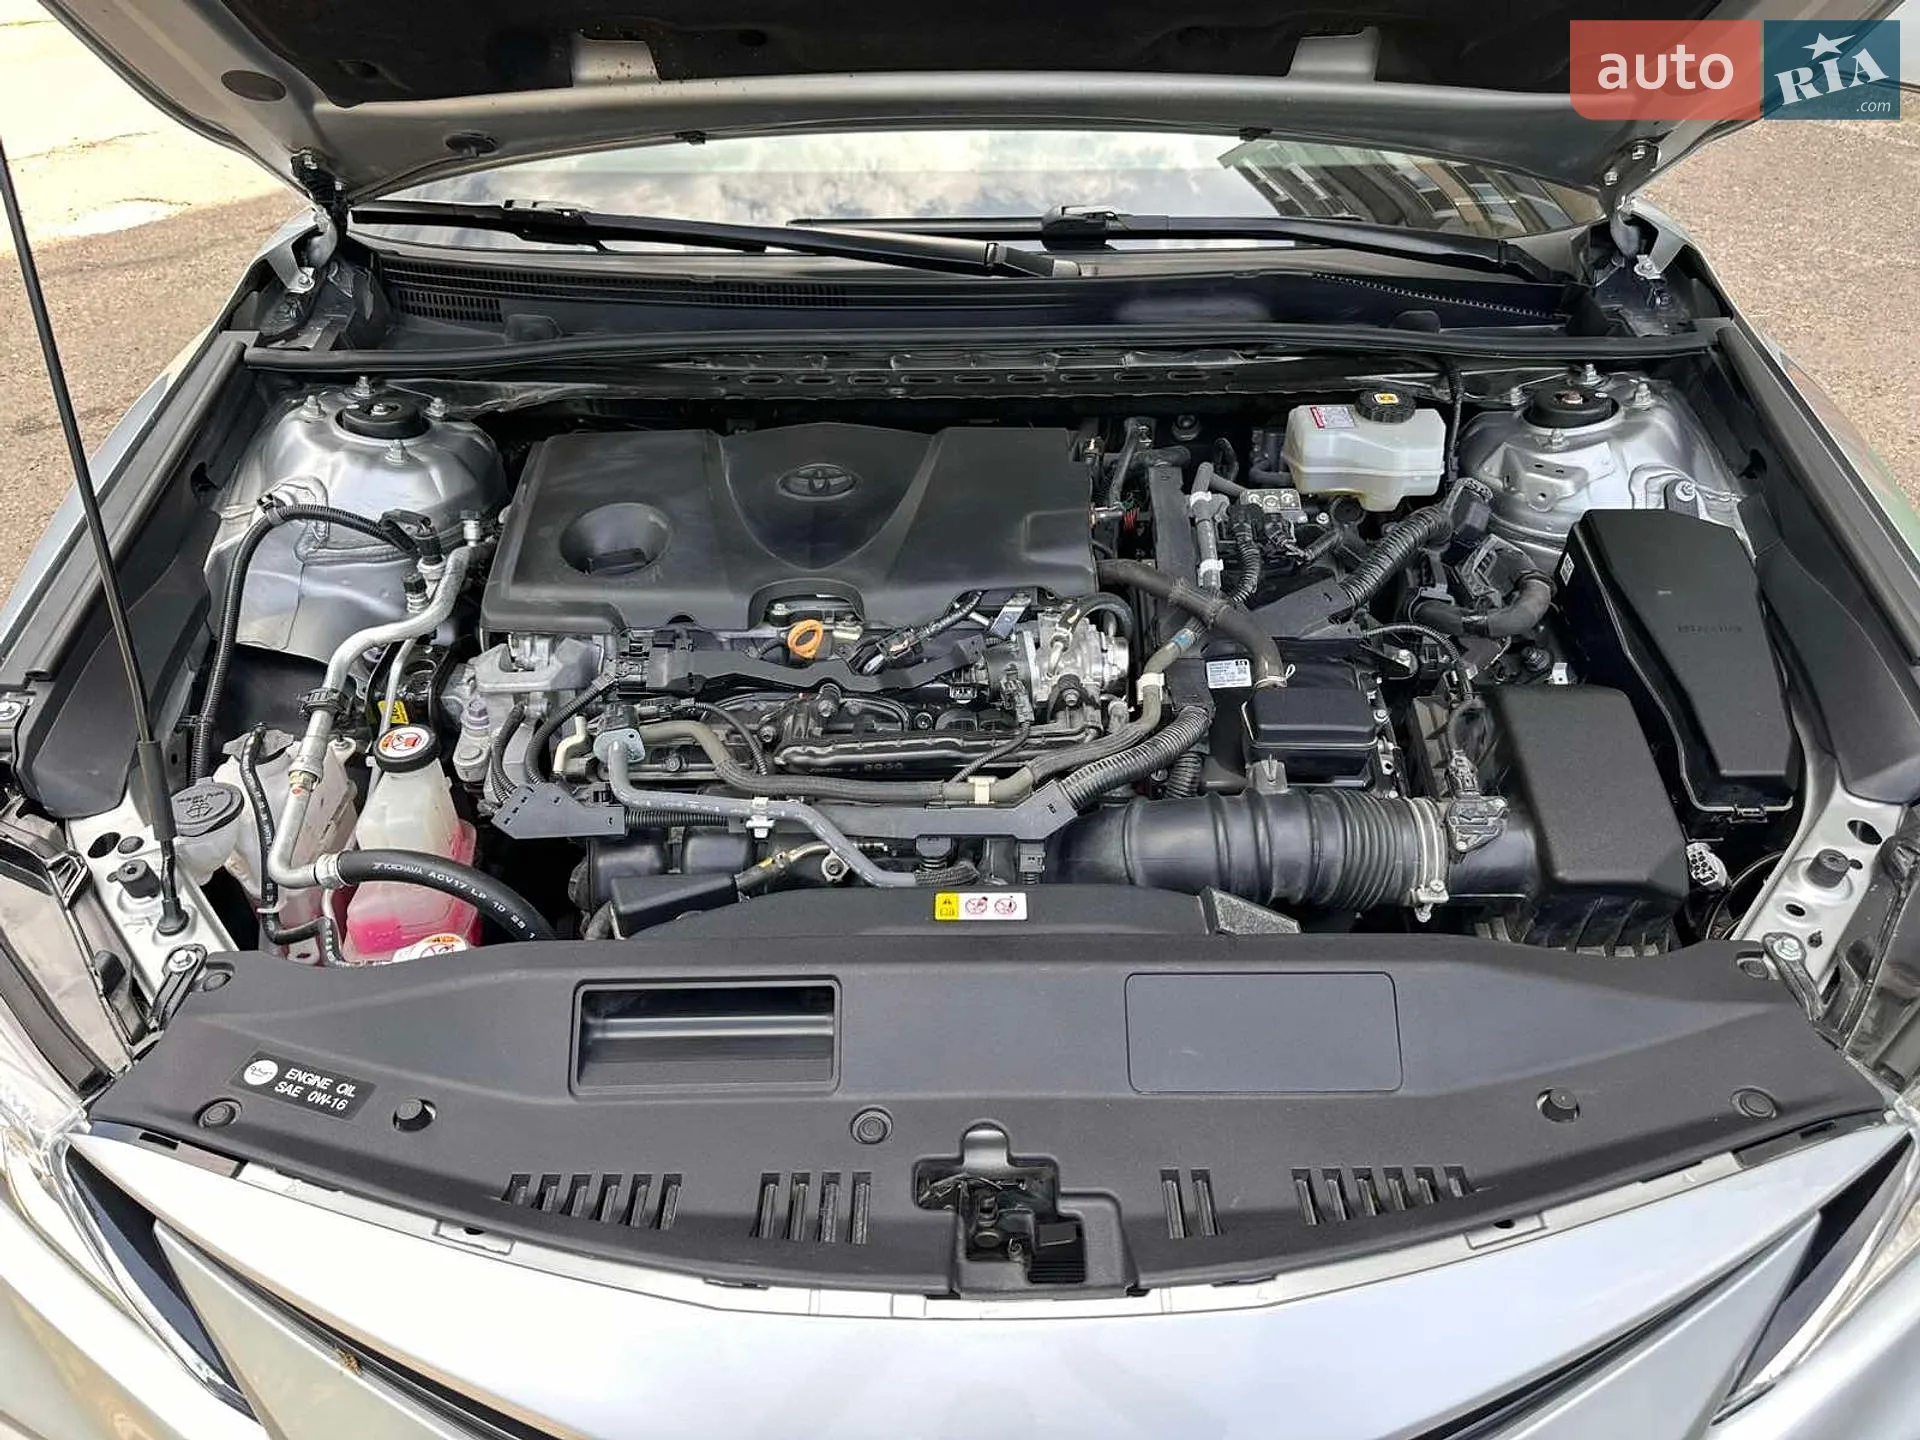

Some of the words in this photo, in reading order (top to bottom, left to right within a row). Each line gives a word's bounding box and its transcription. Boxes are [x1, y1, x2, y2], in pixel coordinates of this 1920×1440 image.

[274, 1081, 304, 1098] SAE
[307, 1090, 349, 1111] 0W-16
[285, 1068, 334, 1090] ENGINE
[336, 1082, 357, 1098] OIL
